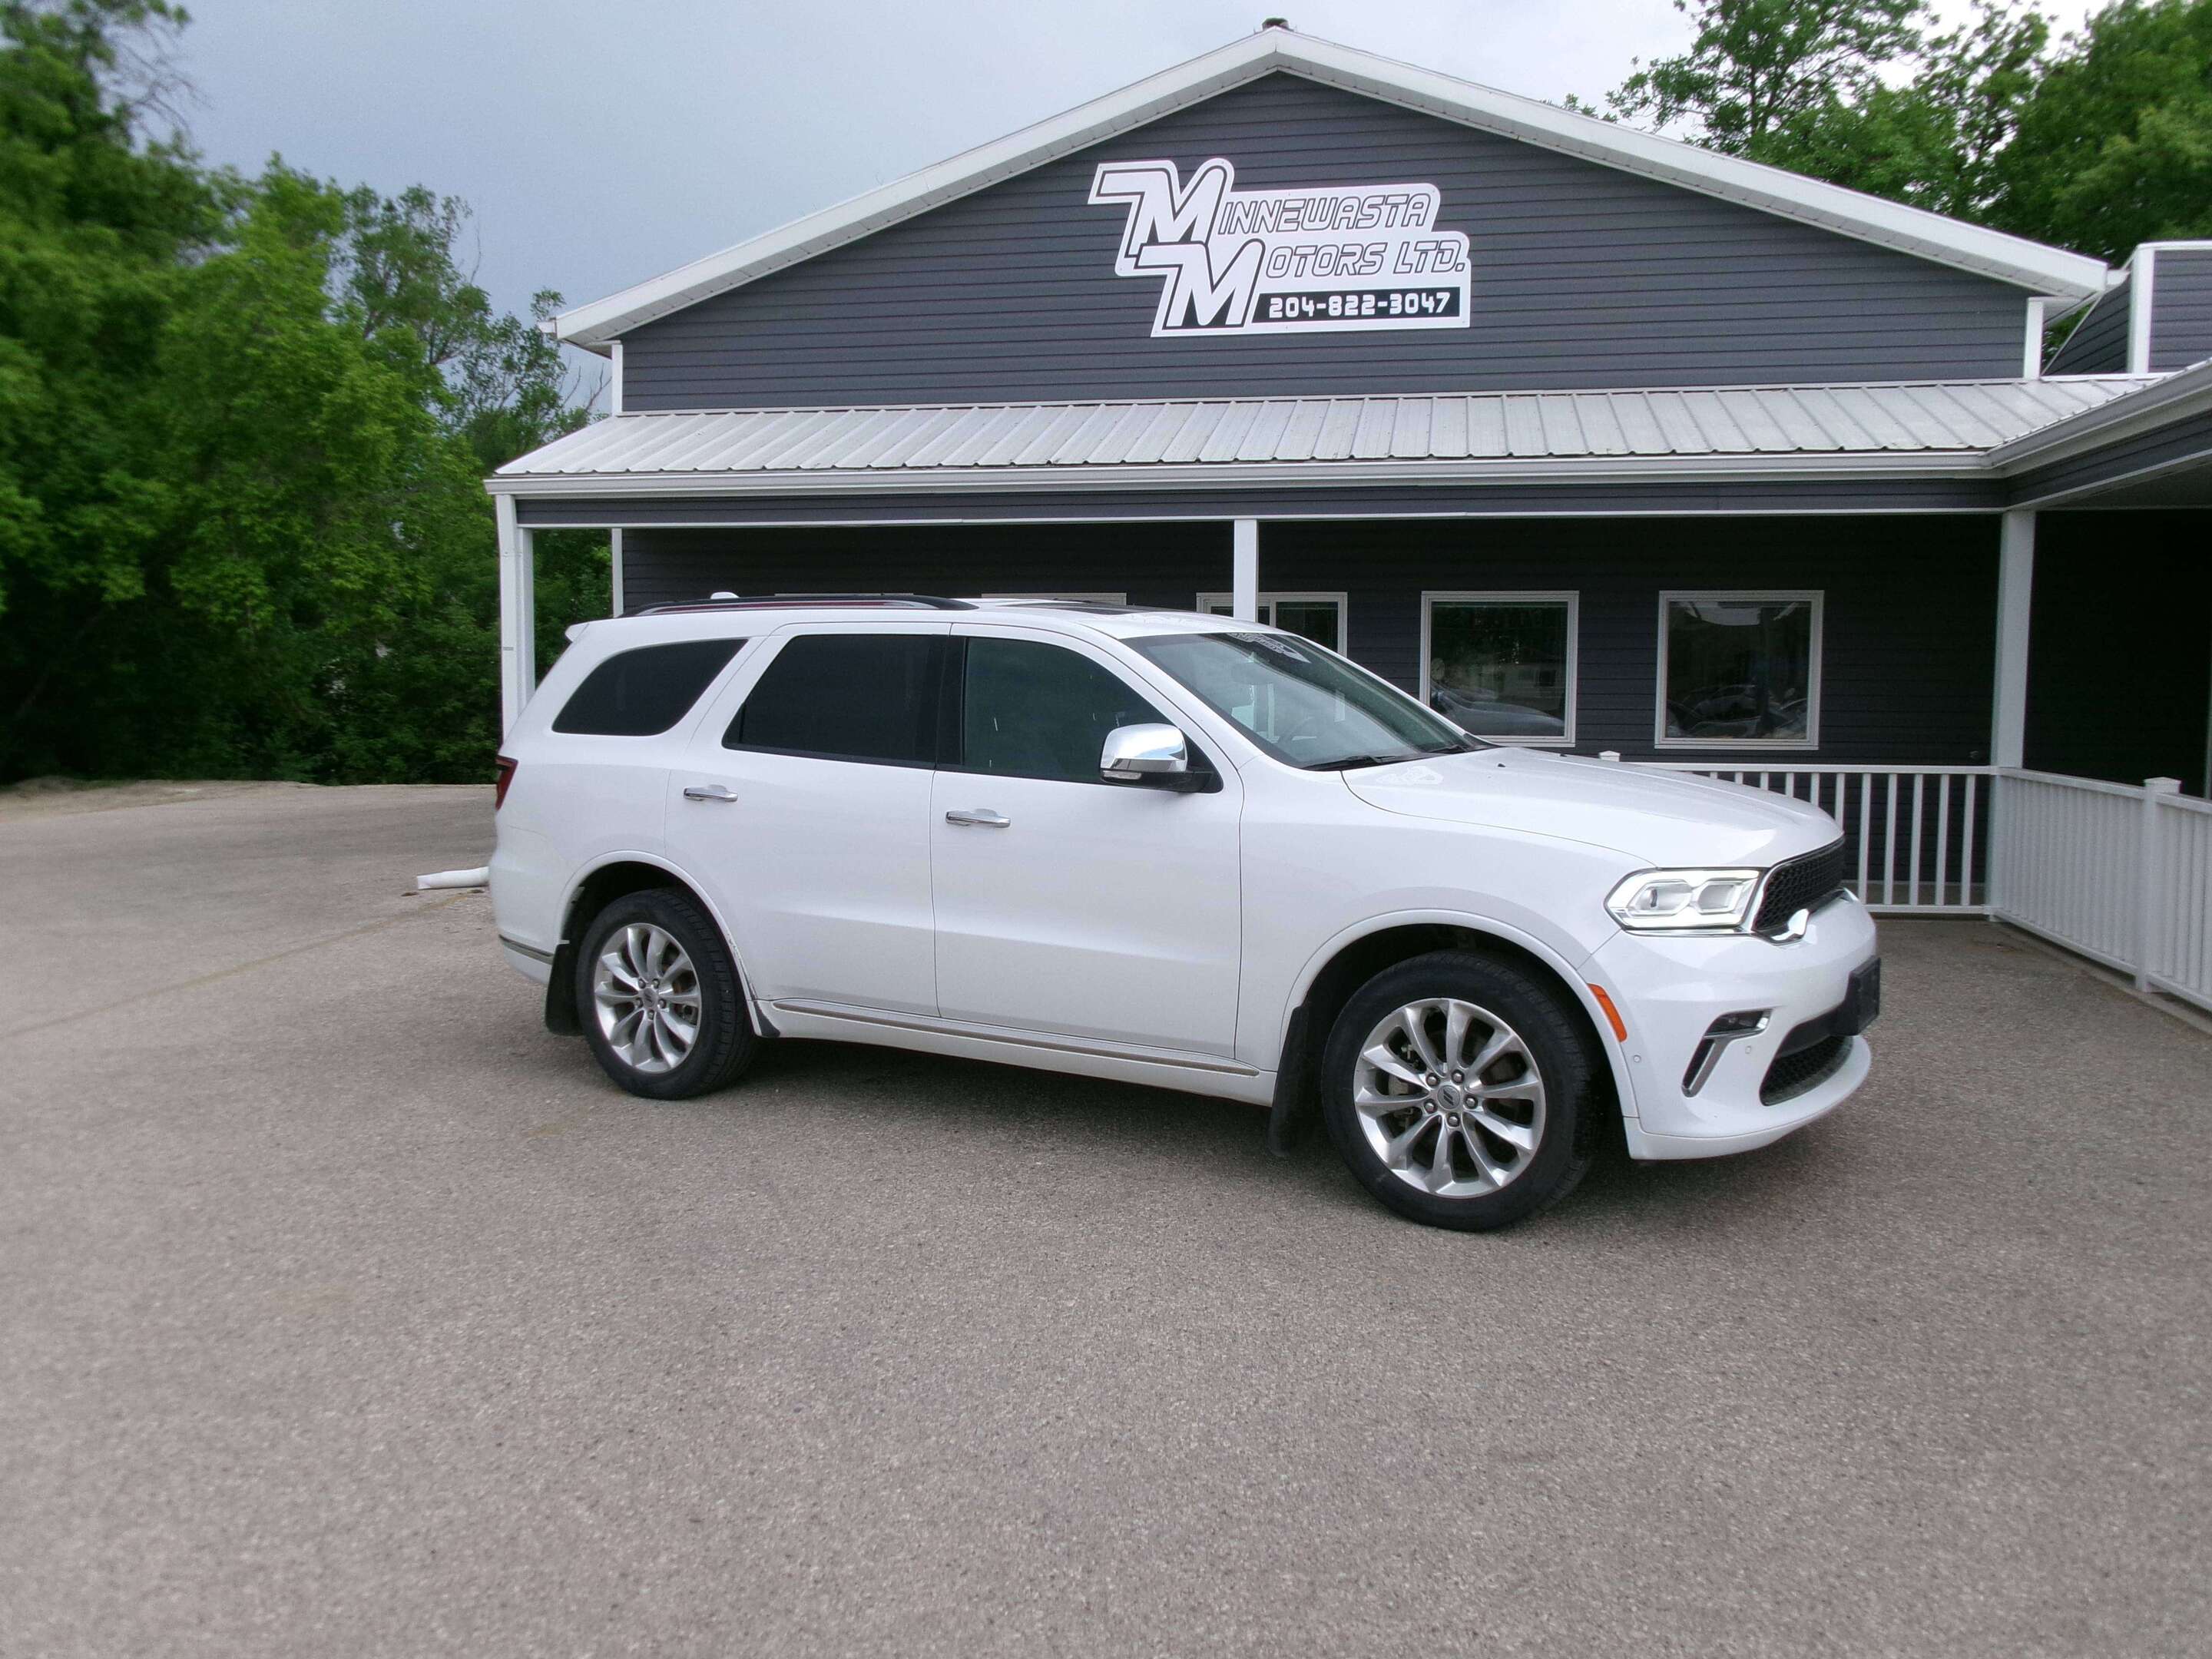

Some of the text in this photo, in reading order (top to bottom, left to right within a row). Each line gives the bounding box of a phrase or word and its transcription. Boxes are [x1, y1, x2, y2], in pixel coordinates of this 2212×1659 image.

[1096, 166, 1431, 258] MINNEWASTA
[1134, 238, 1465, 330] MOTORS LTD.
[1269, 291, 1451, 319] 204-822-3047
